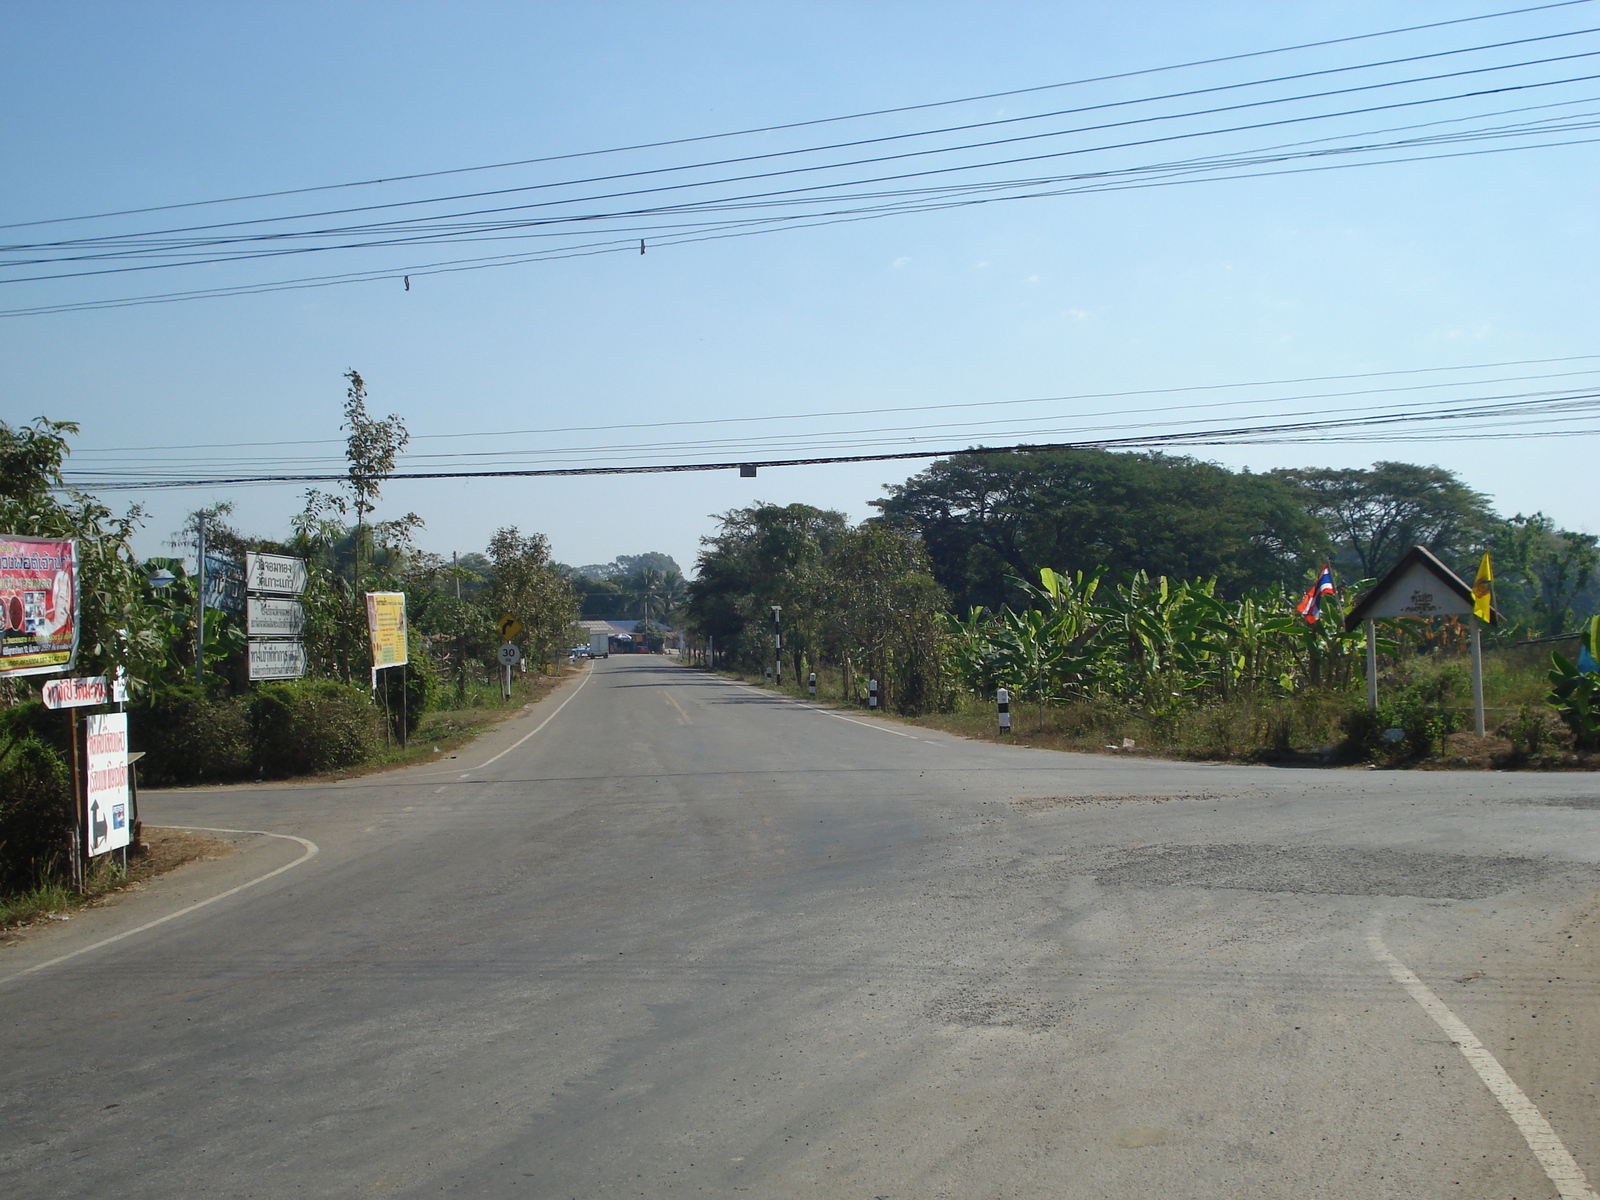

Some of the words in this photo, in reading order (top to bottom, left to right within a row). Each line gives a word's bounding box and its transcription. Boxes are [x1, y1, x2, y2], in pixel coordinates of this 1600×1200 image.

[256, 557, 292, 574] วัดจอมทอง
[256, 571, 294, 589] วัดเกาะแก้ว
[502, 648, 515, 657] 30
